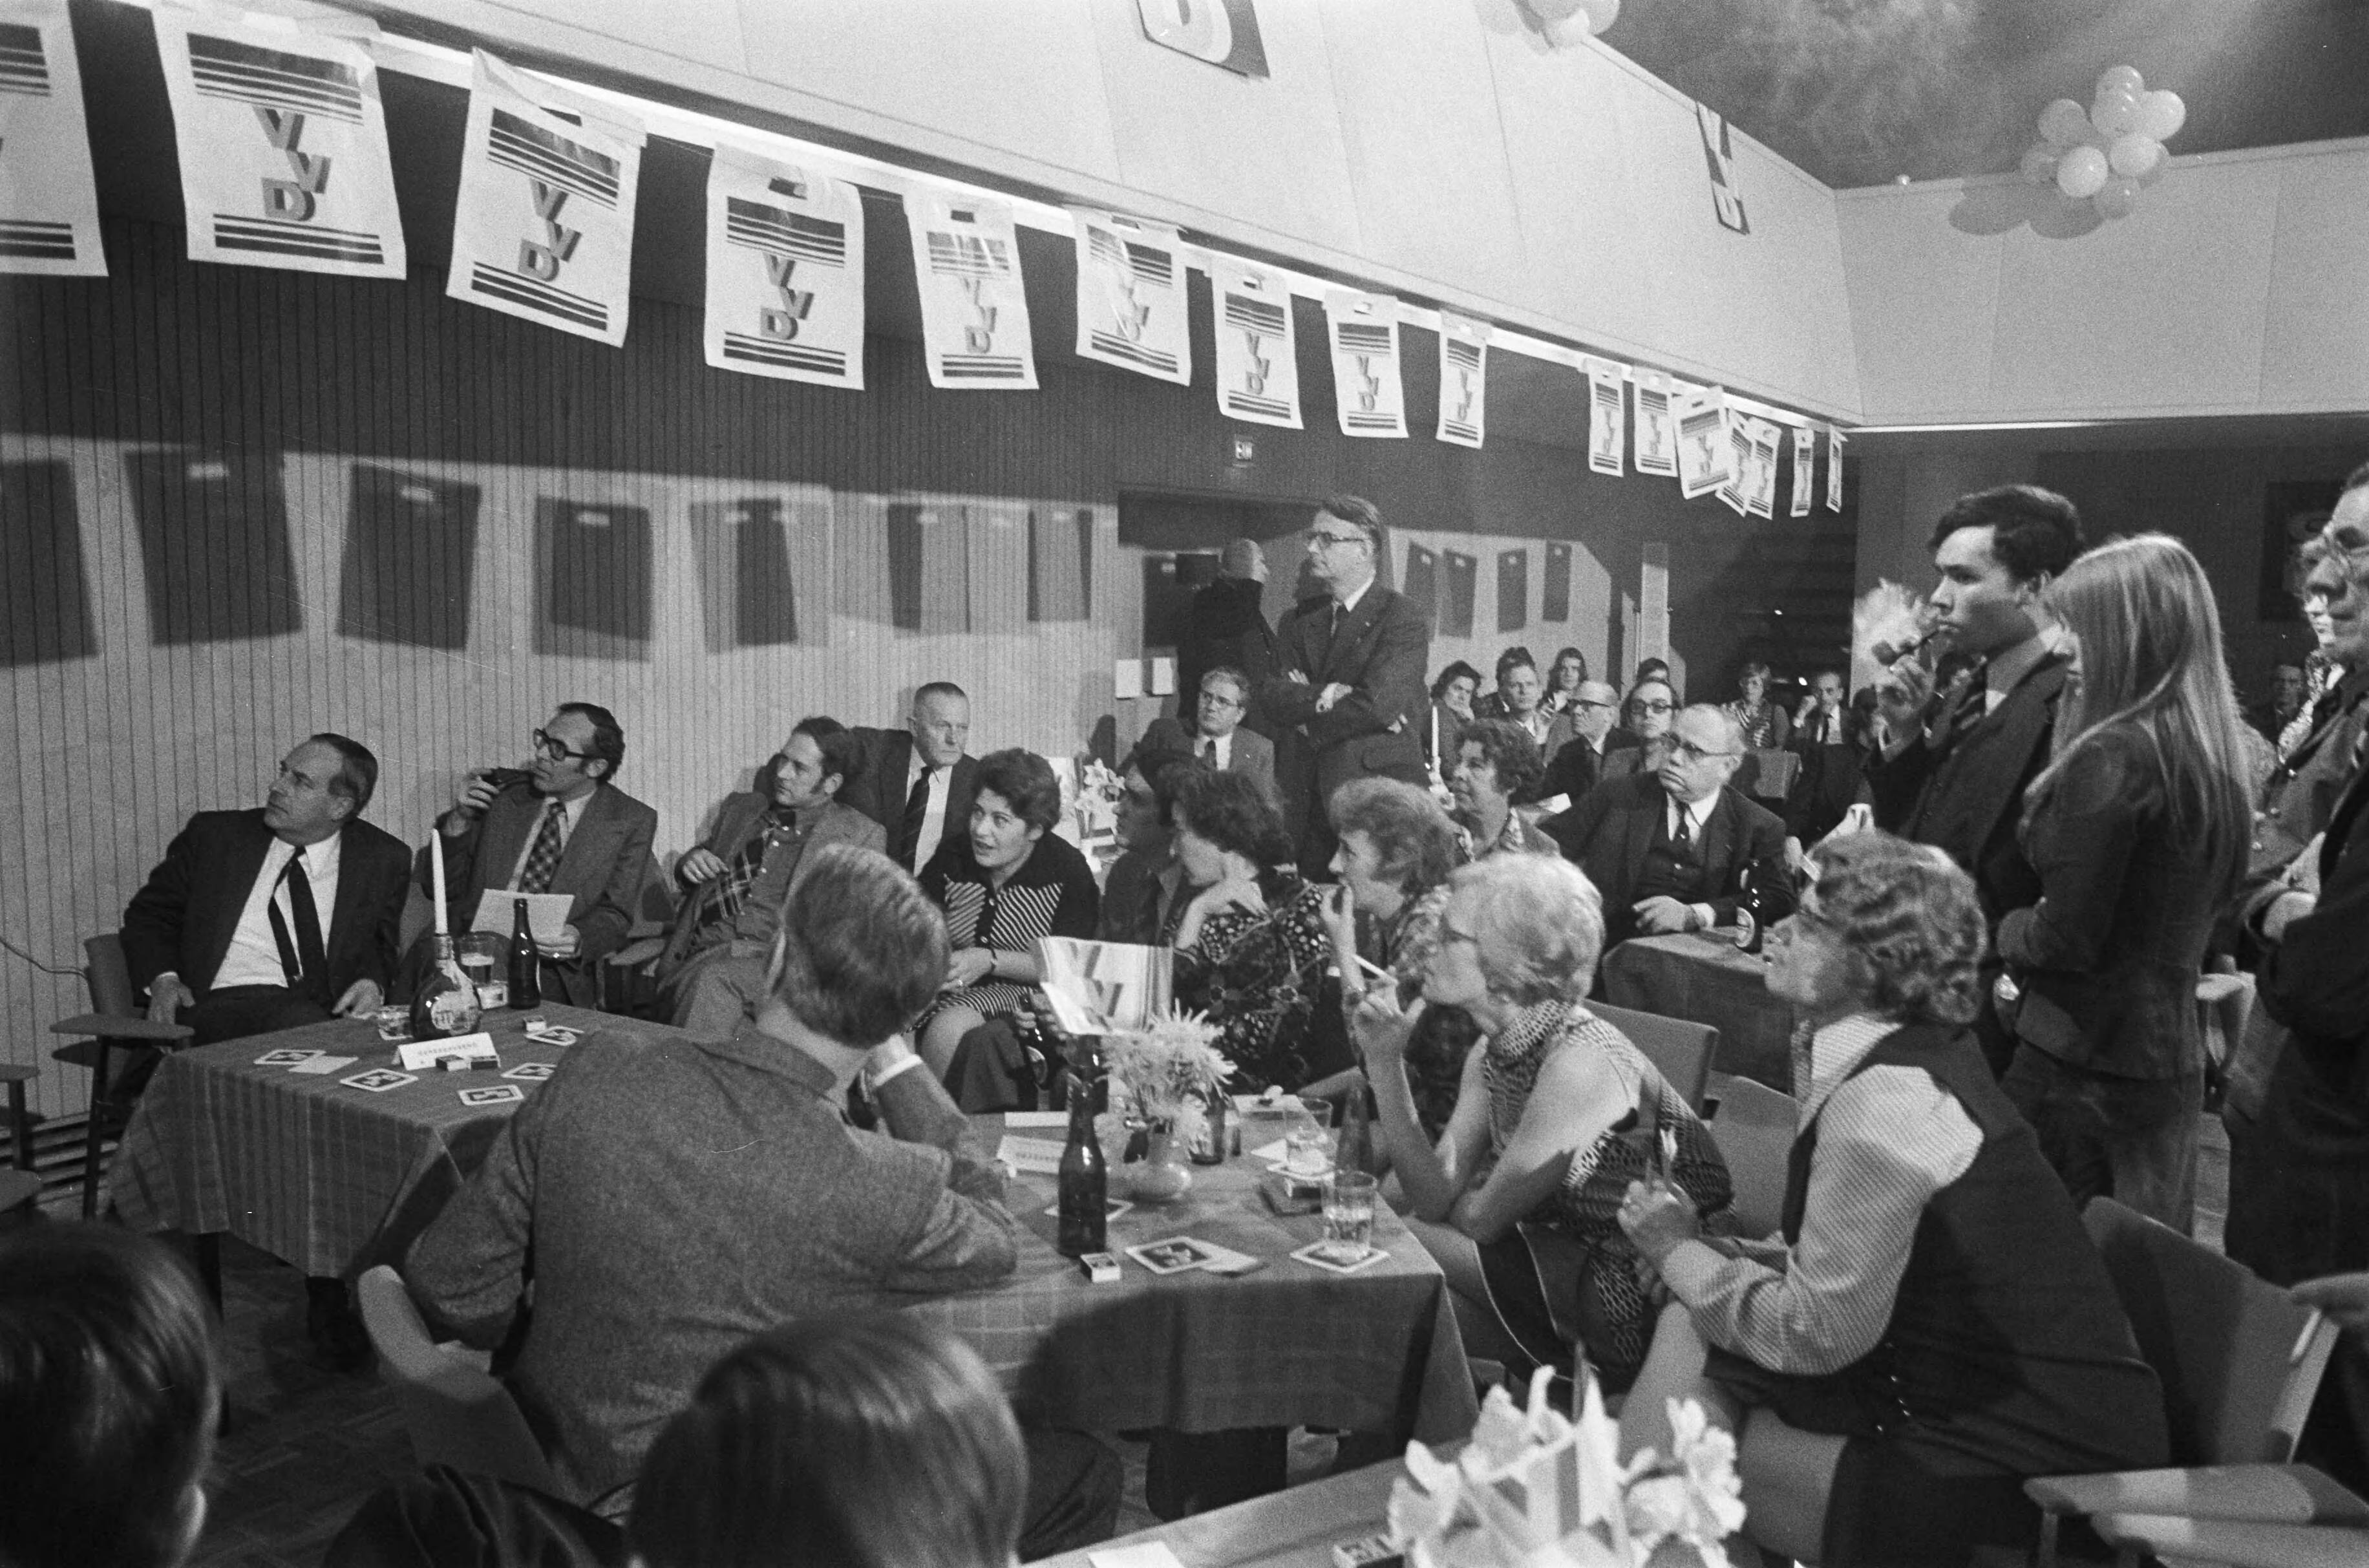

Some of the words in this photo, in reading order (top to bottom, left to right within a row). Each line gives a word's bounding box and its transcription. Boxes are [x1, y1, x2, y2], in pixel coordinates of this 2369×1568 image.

[251, 103, 333, 222] VVD
[518, 178, 582, 282] VVD
[761, 251, 814, 341] VVD
[959, 277, 997, 354] VVD
[1245, 331, 1269, 395] VVD
[1356, 354, 1380, 411] VVD
